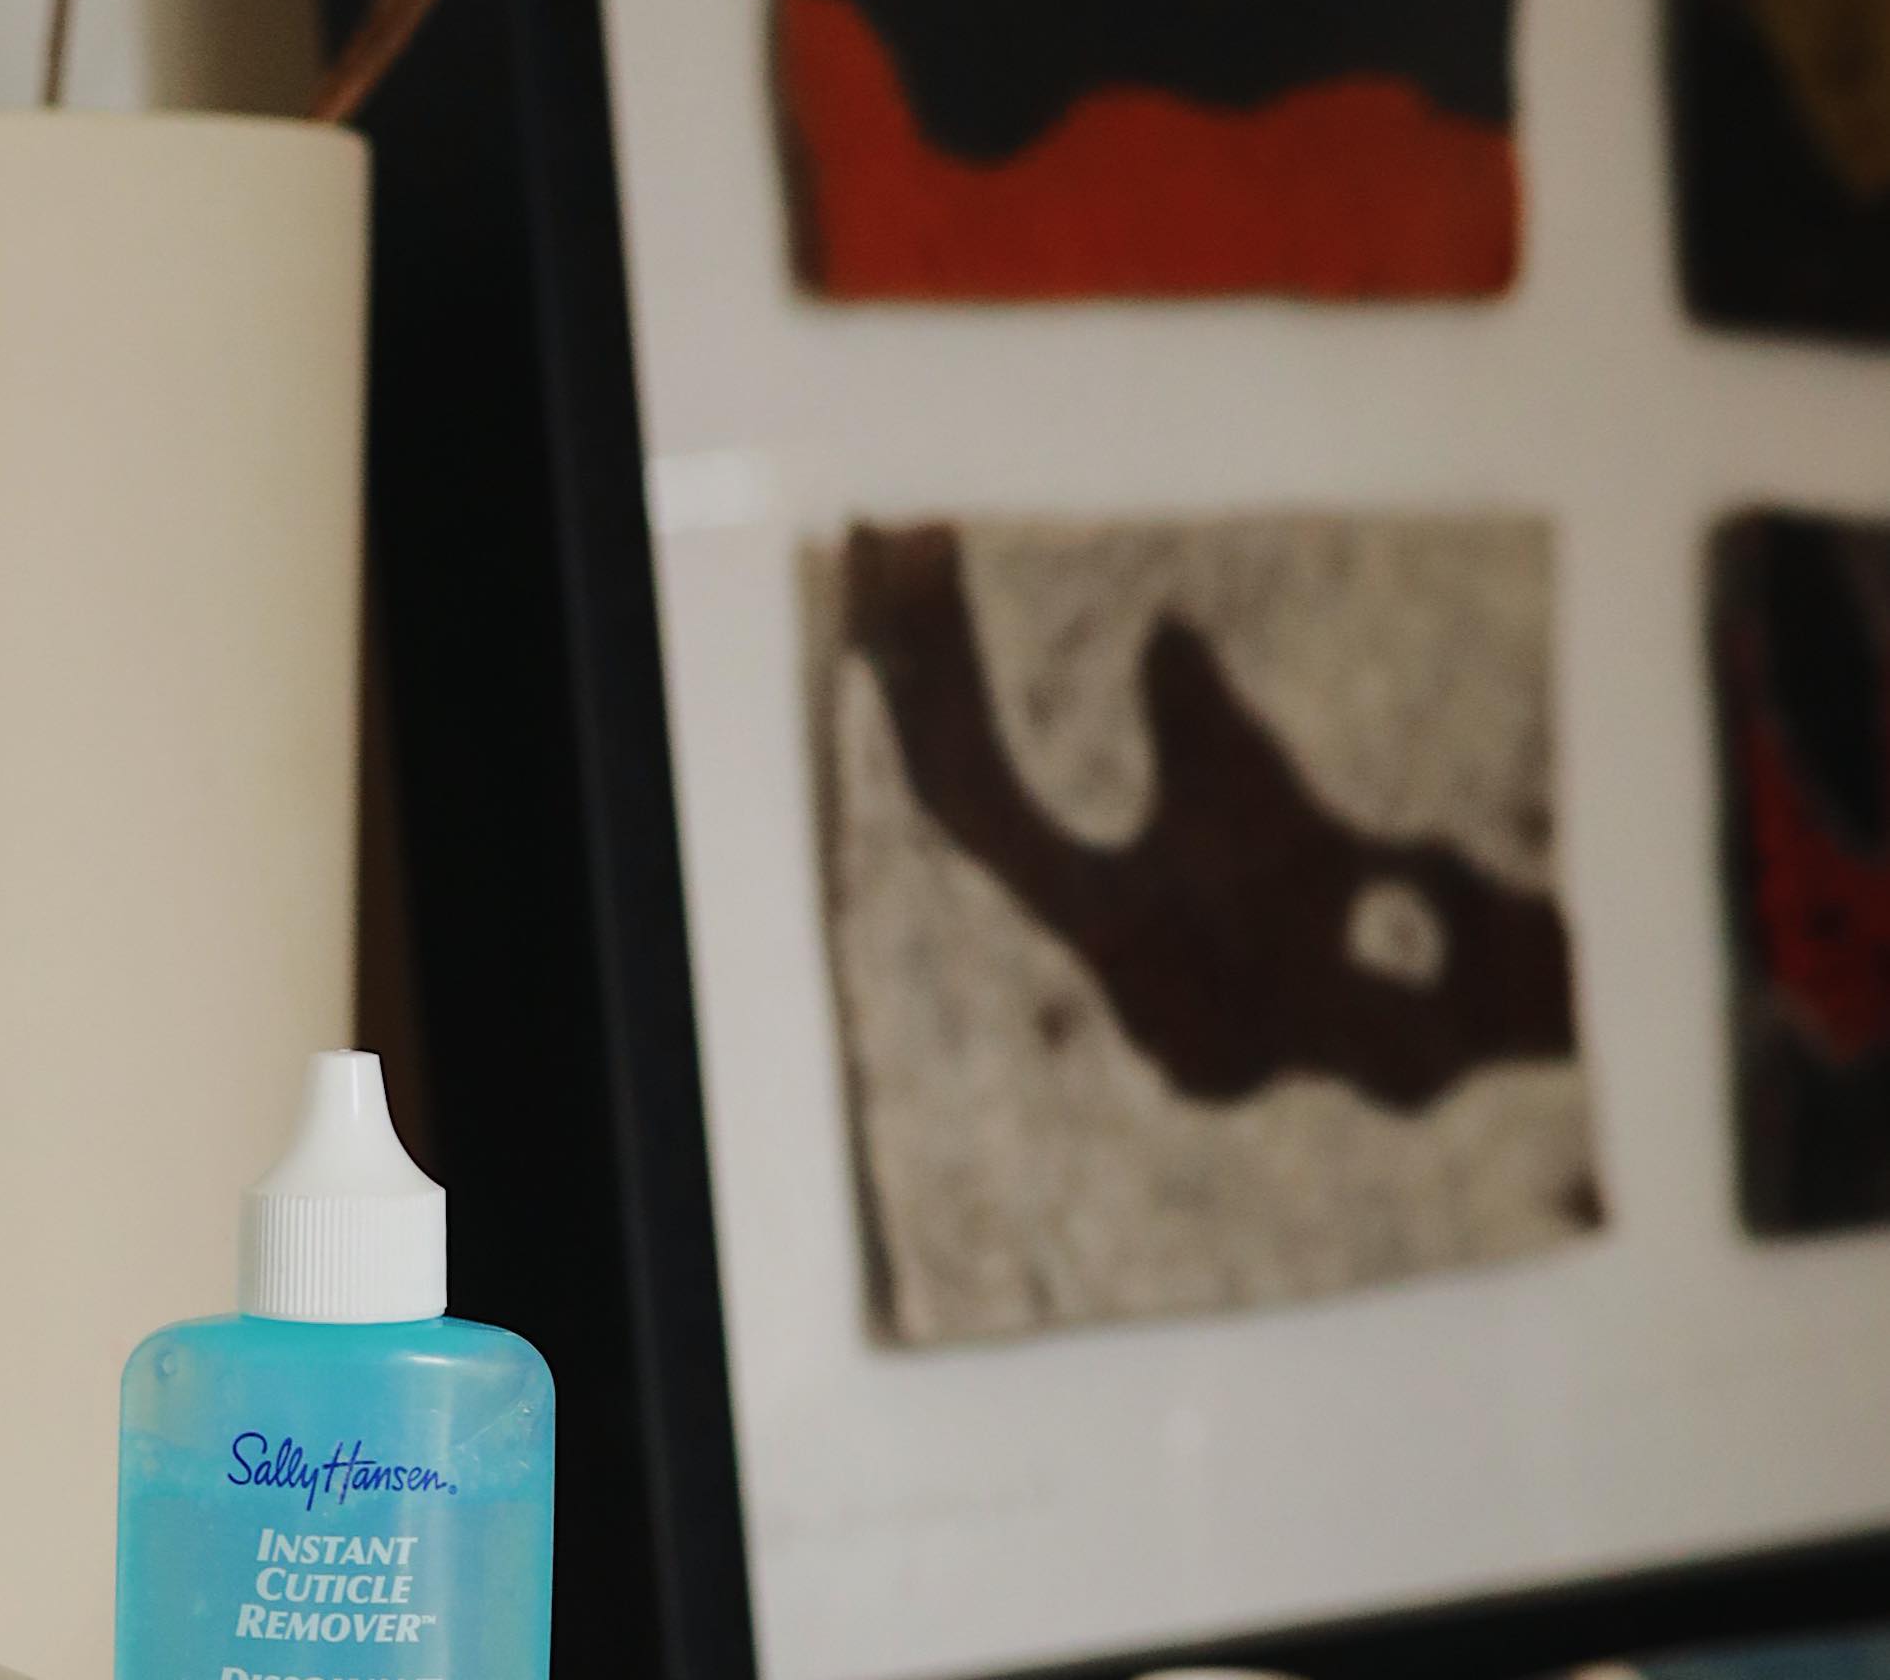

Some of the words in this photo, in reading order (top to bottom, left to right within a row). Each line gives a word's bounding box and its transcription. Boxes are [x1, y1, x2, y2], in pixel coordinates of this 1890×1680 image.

[227, 1431, 320, 1512] Sally
[256, 1528, 419, 1566] INSTANT
[255, 1567, 413, 1604] CUTICLE
